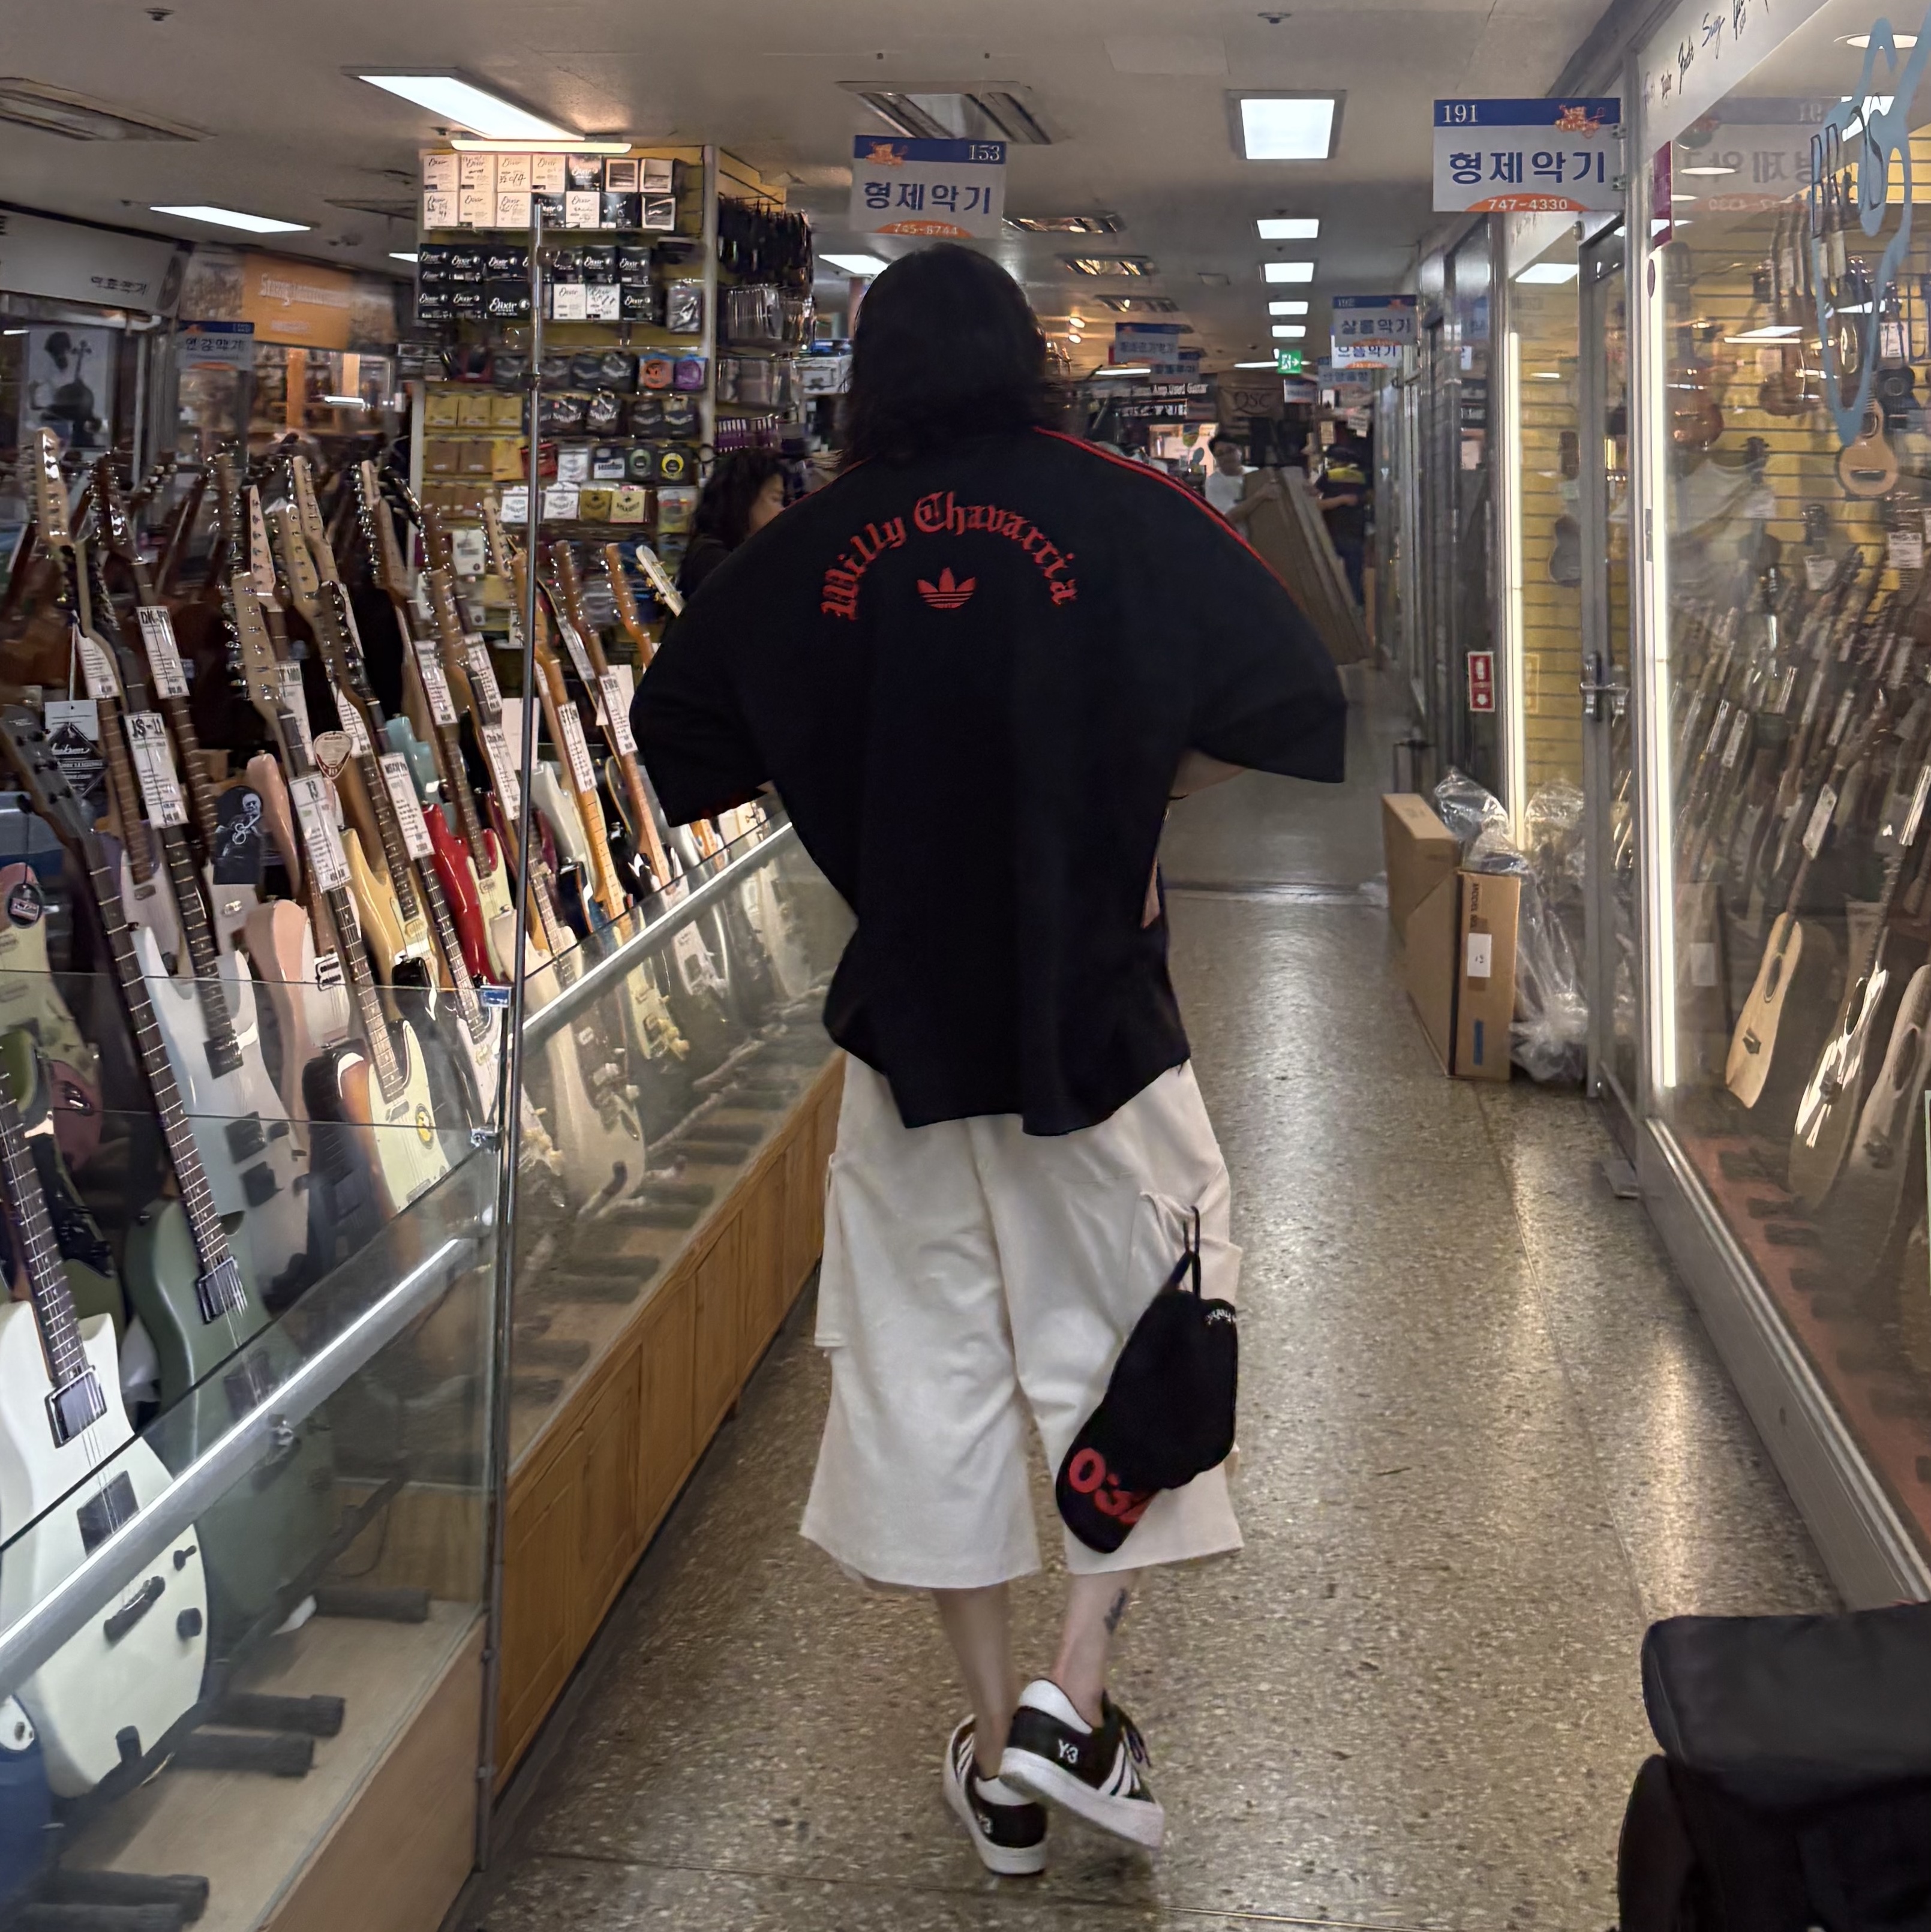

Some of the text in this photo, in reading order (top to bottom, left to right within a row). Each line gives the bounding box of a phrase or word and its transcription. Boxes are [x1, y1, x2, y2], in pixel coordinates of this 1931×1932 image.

[1442, 104, 1479, 124] 191
[968, 144, 1001, 161] 153
[1449, 151, 1605, 184] 형제악기
[864, 182, 991, 214] 형제악기
[1488, 199, 1568, 211] 747-4330
[489, 256, 508, 266] Elixir
[584, 256, 603, 268] Elixir
[620, 257, 639, 268] Elixir
[489, 298, 518, 312] Elixir
[624, 296, 644, 306] Elixir
[913, 491, 1079, 606] Chavarria
